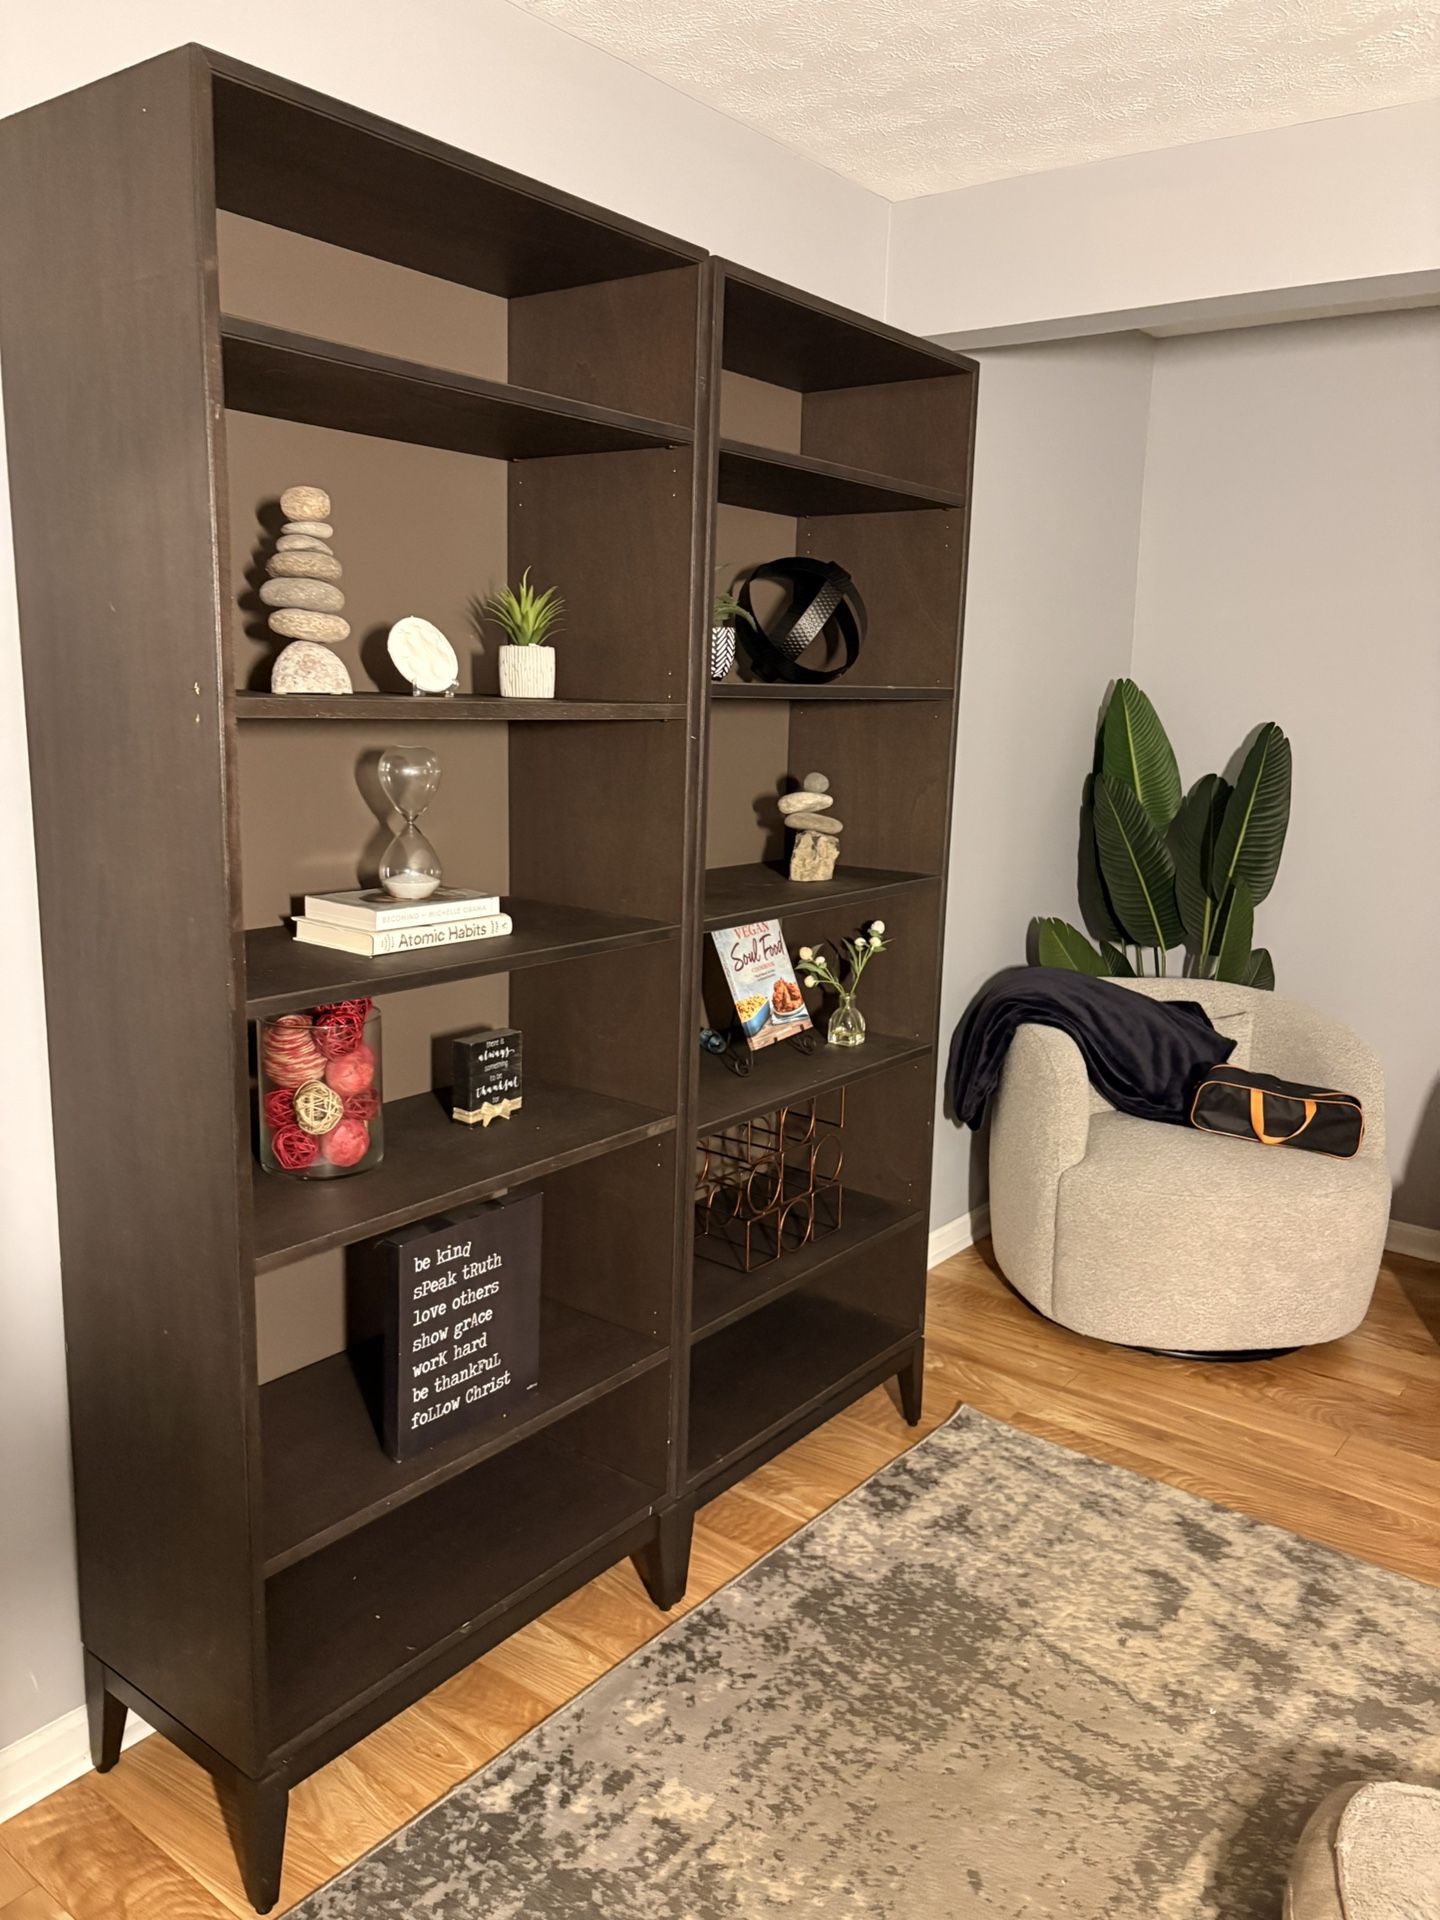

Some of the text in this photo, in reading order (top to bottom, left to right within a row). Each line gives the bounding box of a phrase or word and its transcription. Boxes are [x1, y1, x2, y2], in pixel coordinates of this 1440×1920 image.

[382, 912, 420, 924] BECOMING
[463, 904, 487, 913] OBAMA
[398, 921, 487, 949] Atomic Habits
[733, 921, 770, 939] VEGAN
[730, 930, 785, 972] Soul Food
[478, 1046, 515, 1062] always
[476, 1075, 519, 1098] thankful
[413, 1241, 472, 1273] be kind
[462, 1253, 502, 1280] tRuth
[413, 1281, 500, 1327] love others
[412, 1309, 493, 1352] show grAce
[453, 1332, 487, 1361] hard
[412, 1387, 429, 1403] be
[465, 1369, 512, 1405] Christ
